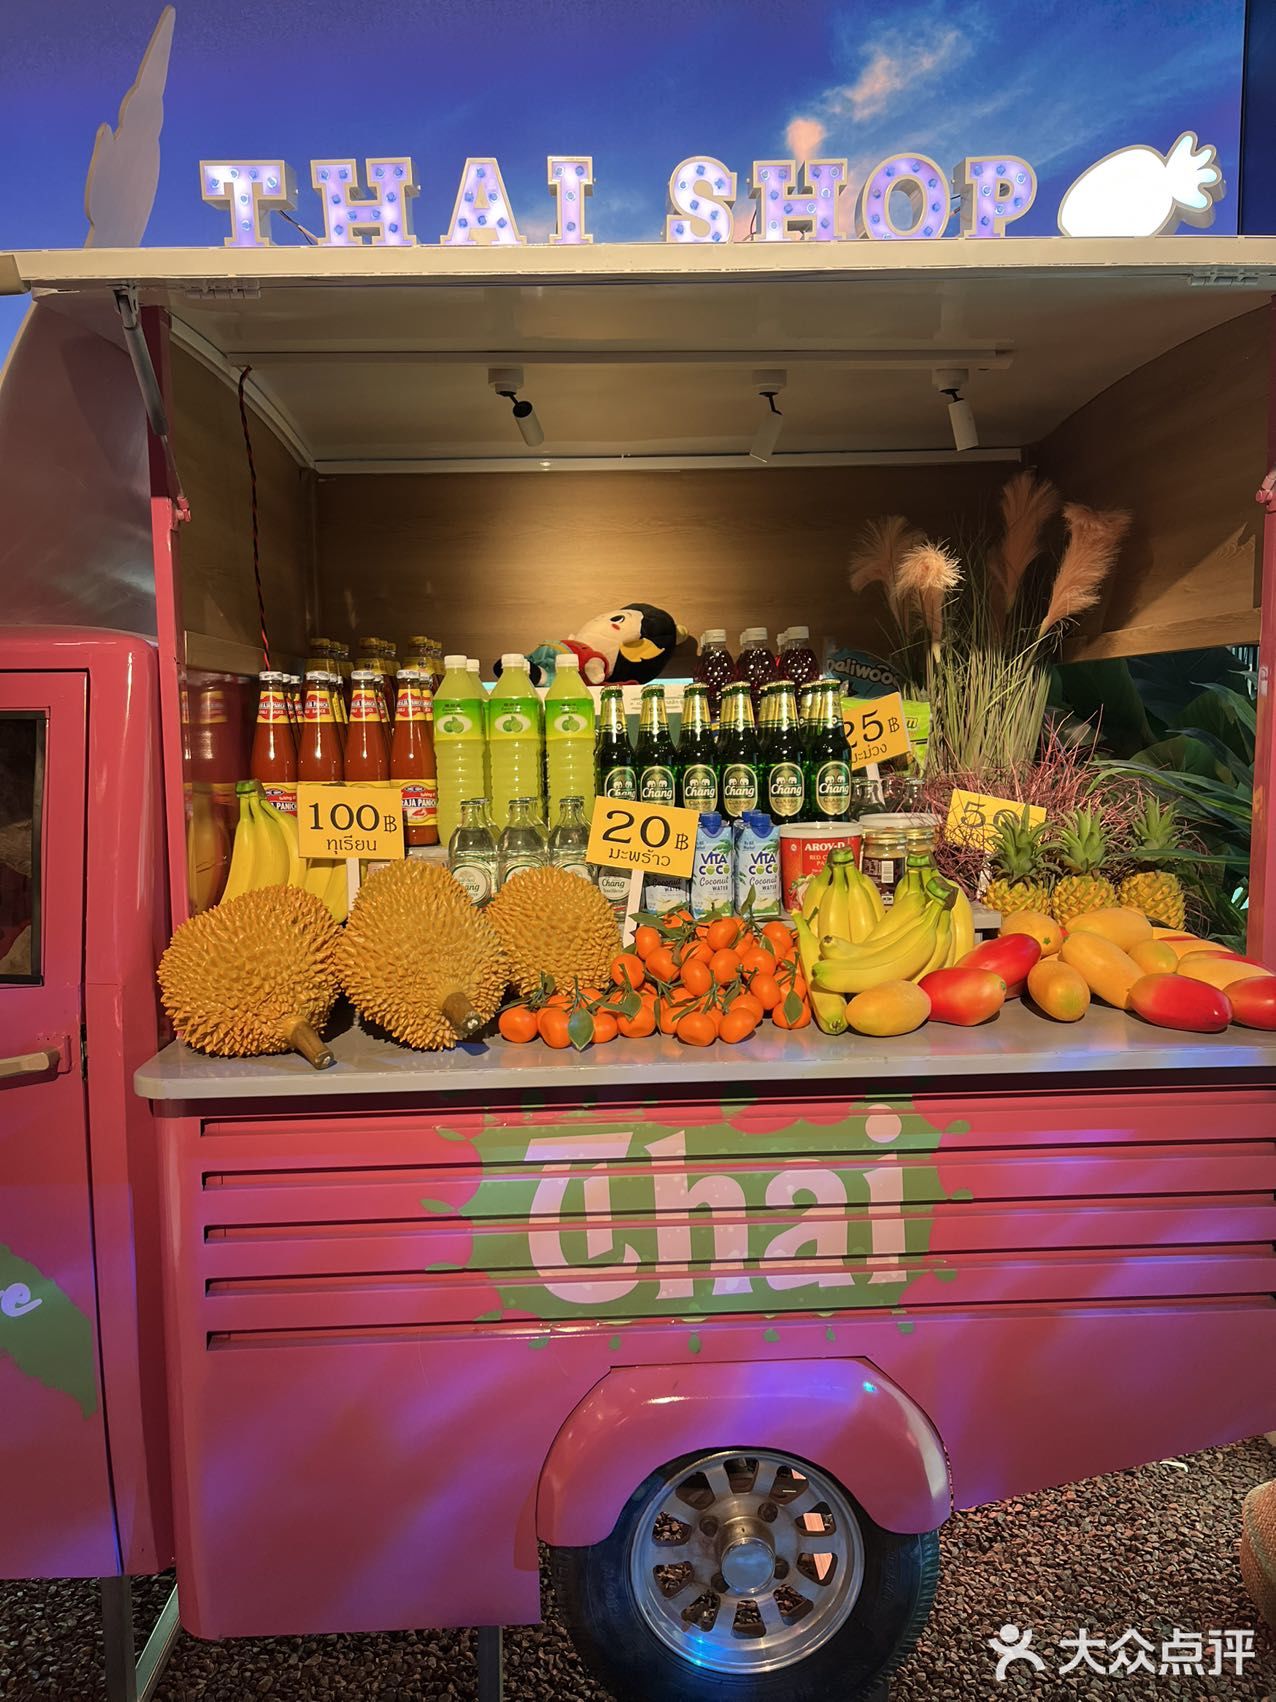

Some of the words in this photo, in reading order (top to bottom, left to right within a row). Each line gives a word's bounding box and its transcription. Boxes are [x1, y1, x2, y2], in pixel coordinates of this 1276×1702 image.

[199, 156, 594, 248] THAI
[666, 153, 1038, 244] SHOP
[642, 787, 673, 800] Chang
[685, 785, 716, 798] Chang
[724, 784, 755, 798] Chang
[771, 783, 802, 797] Chang
[819, 782, 849, 795] Chang
[326, 835, 378, 855] ทุเรียน
[608, 848, 671, 867] มะพร้าว
[700, 851, 728, 865] VITA
[750, 851, 777, 865] VITA
[601, 878, 625, 889] Chang
[523, 1103, 908, 1304] Thai
